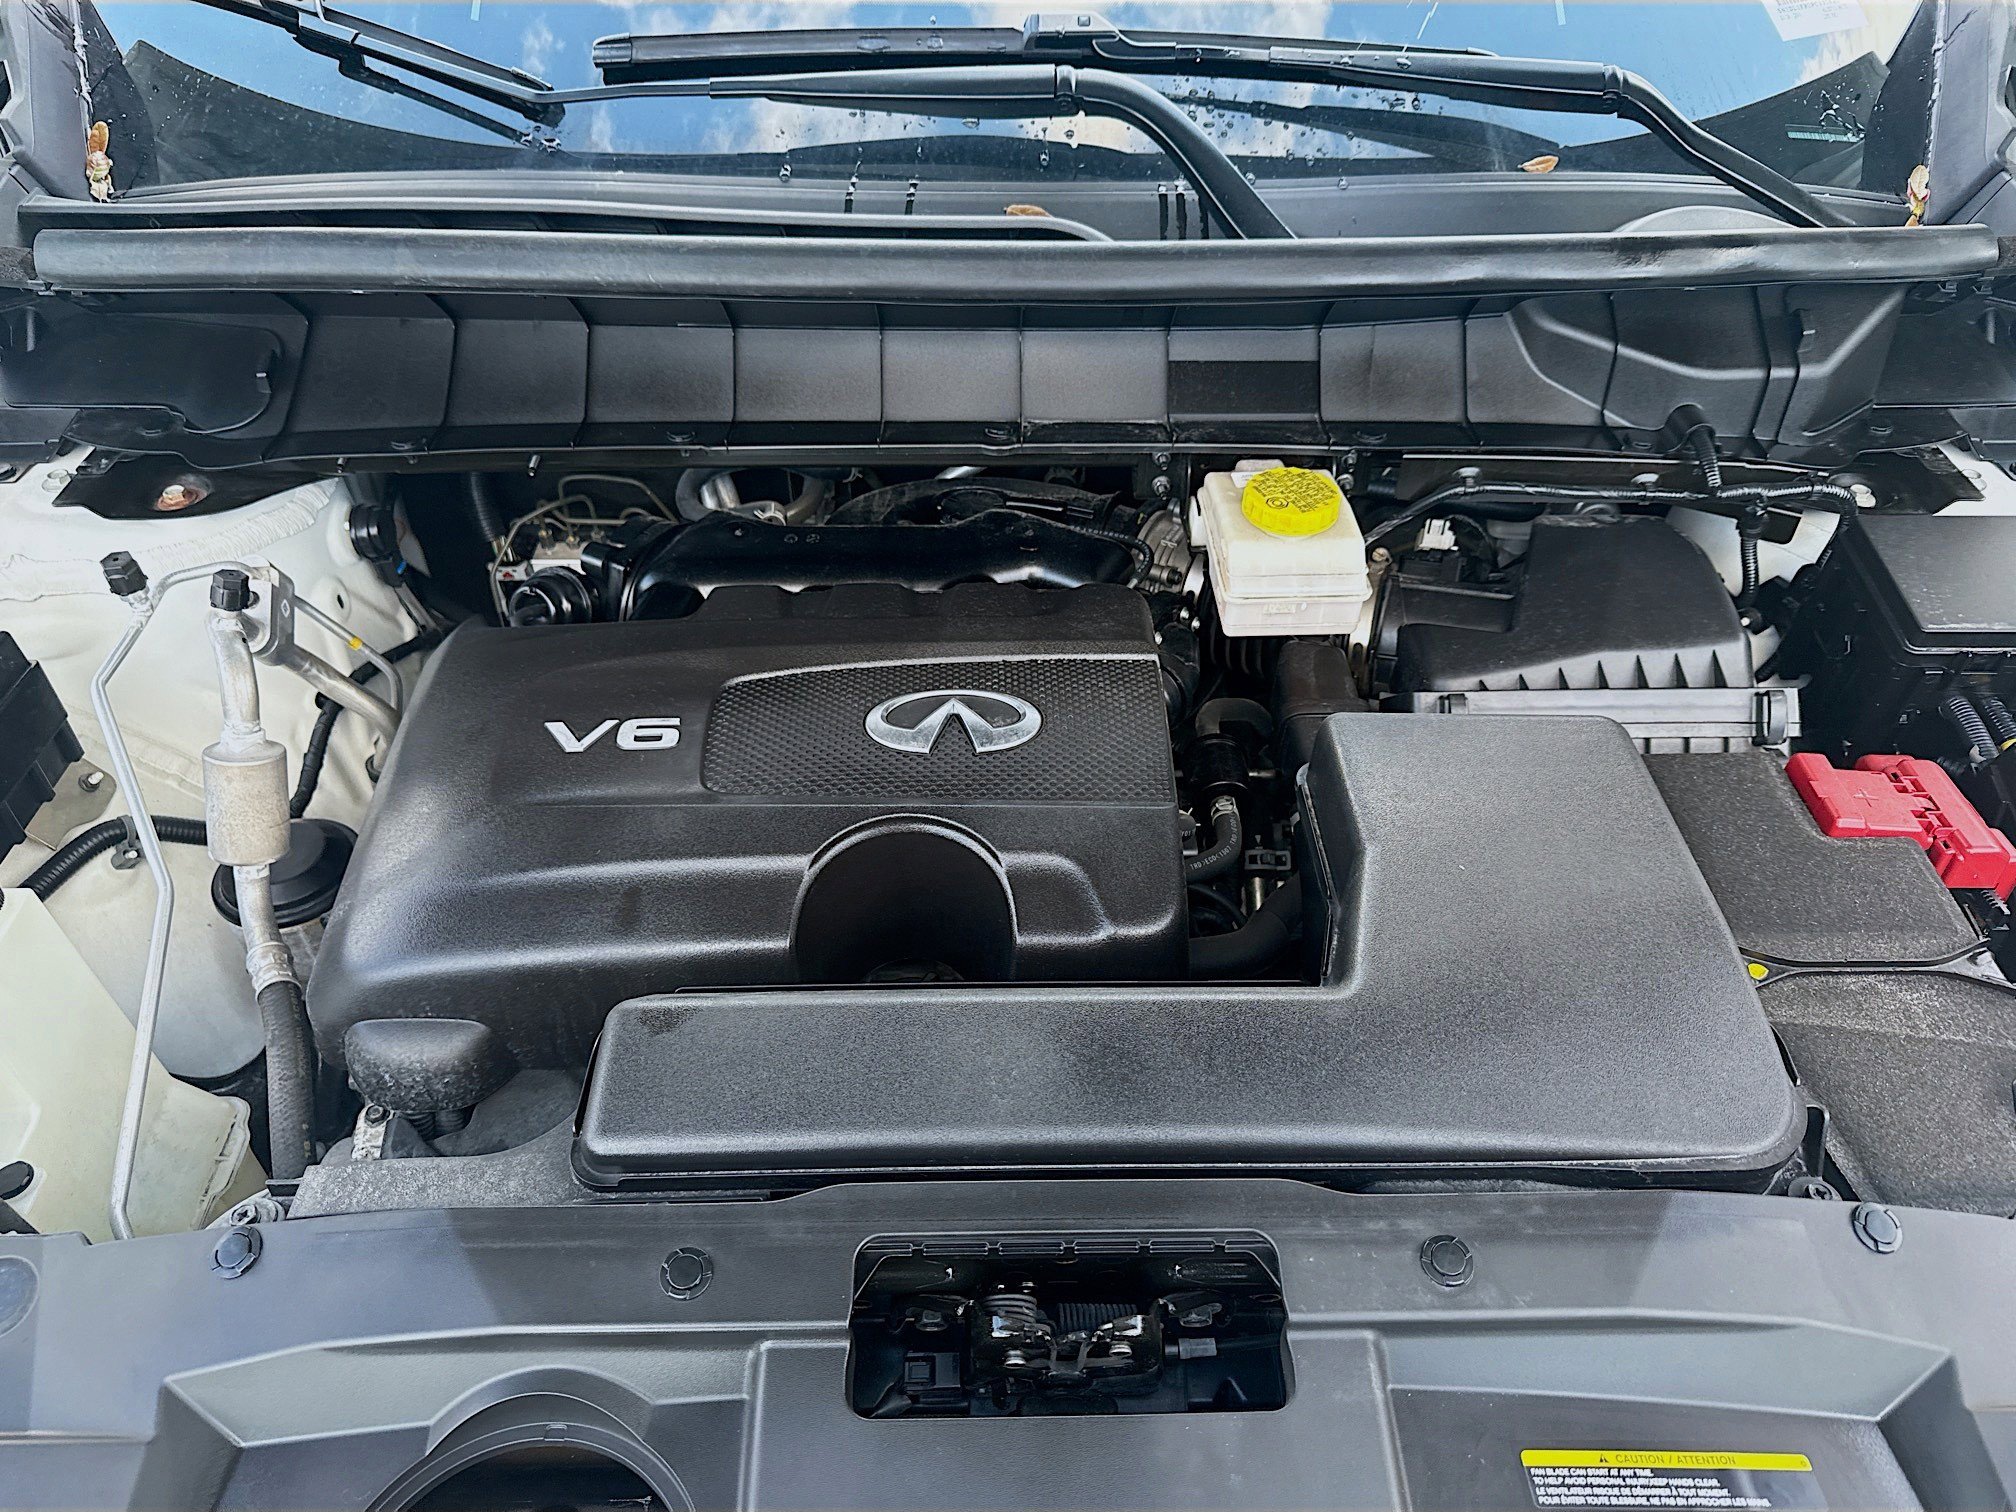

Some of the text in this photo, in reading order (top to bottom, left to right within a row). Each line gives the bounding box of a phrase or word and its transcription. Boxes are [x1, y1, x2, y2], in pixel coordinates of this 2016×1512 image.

[544, 717, 681, 752] V6
[1615, 1454, 1664, 1464] CAUTION
[1677, 1455, 1736, 1465] ATTENTION
